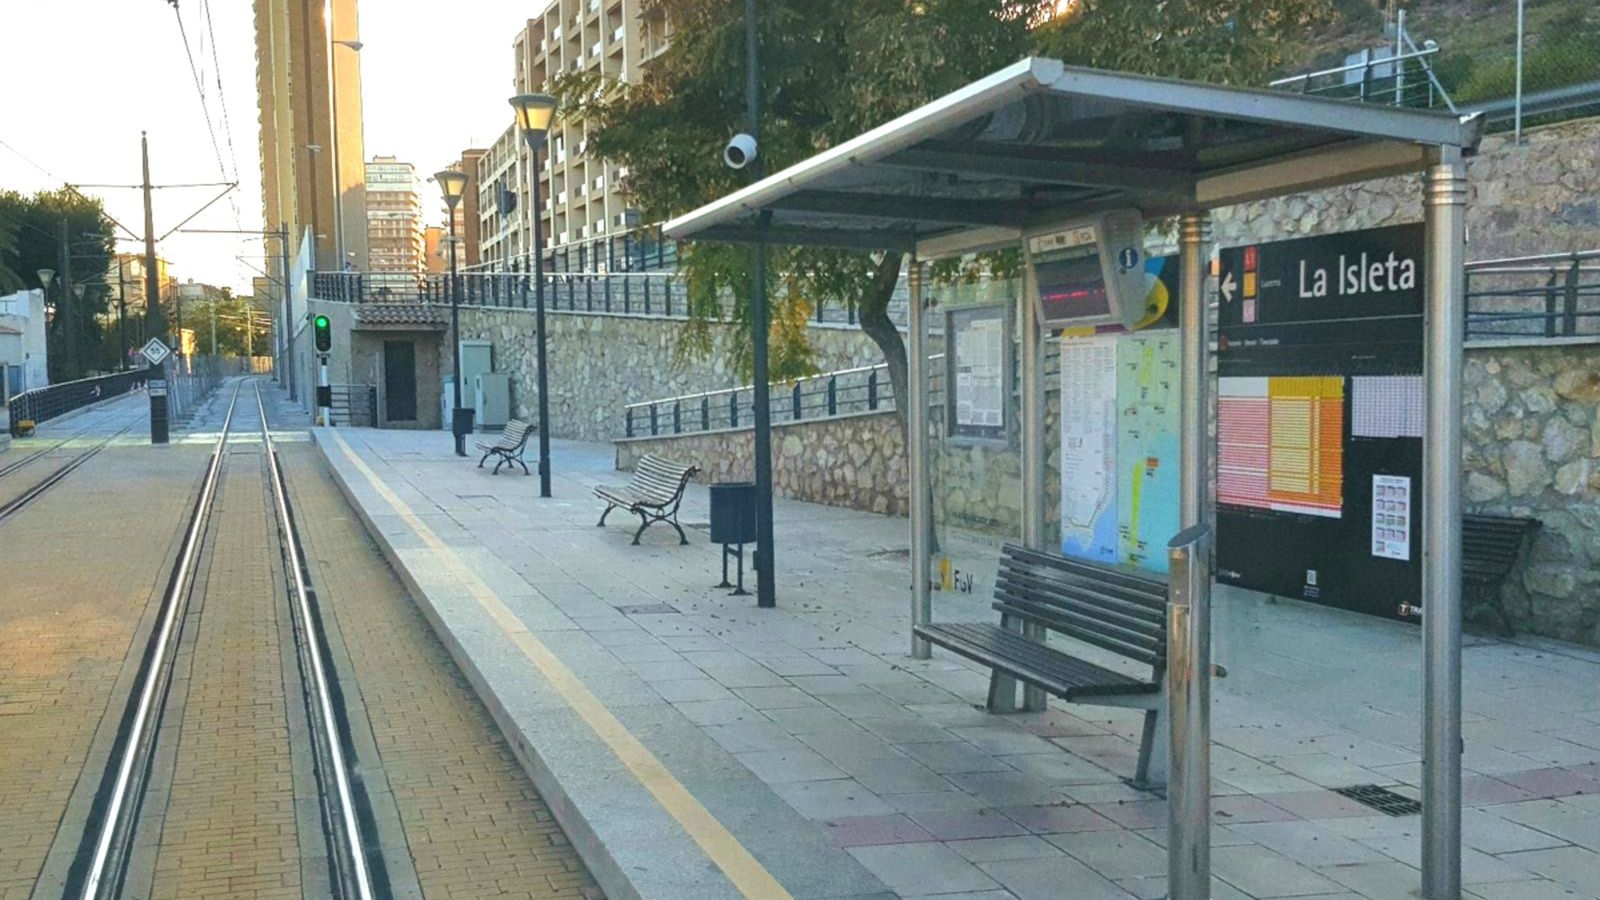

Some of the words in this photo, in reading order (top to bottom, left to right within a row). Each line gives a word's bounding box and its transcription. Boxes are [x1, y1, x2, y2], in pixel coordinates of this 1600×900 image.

[1298, 260, 1328, 298] La
[1338, 251, 1415, 296] Isleta
[954, 569, 973, 595] FGV
